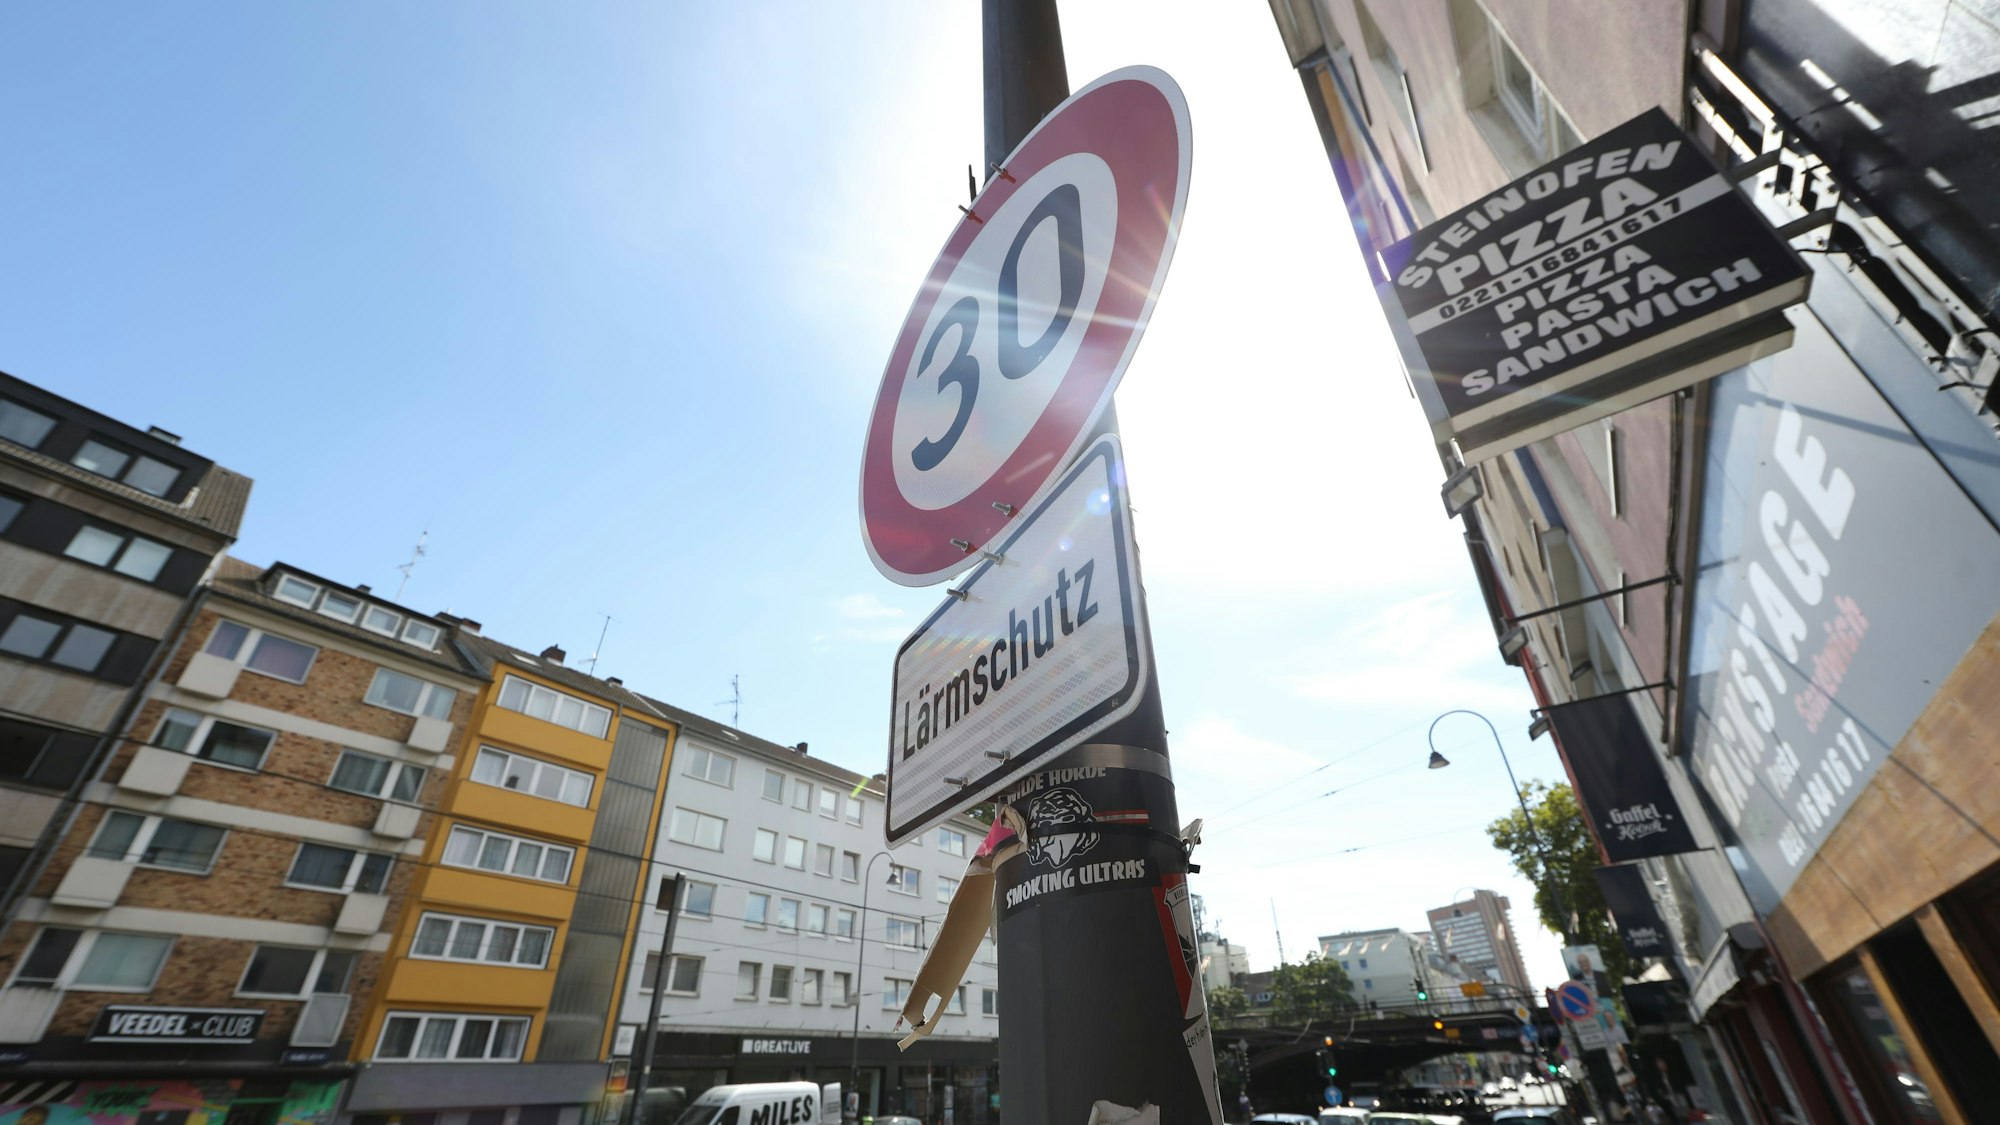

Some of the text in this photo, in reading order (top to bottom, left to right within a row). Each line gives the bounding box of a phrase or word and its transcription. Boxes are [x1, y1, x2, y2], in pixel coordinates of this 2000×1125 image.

[1397, 140, 1682, 289] STEINOFEN
[1436, 177, 1658, 296] PIZZA
[1495, 244, 1652, 323] PIZZA
[1501, 264, 1677, 350] PASTA
[911, 183, 1085, 471] 30
[1461, 257, 1763, 395] SANDWICH
[1709, 401, 1855, 827] BACKSTAGE
[903, 558, 1098, 761] Lärmschutz
[1048, 766, 1106, 786] HORDE
[1609, 803, 1661, 824] Gaffel
[1006, 859, 1145, 909] SMOKING ULTRAS
[108, 1012, 255, 1037] VEEDEL CLUB
[753, 1039, 812, 1054] GREATLIVE
[751, 1094, 814, 1125] MILES
